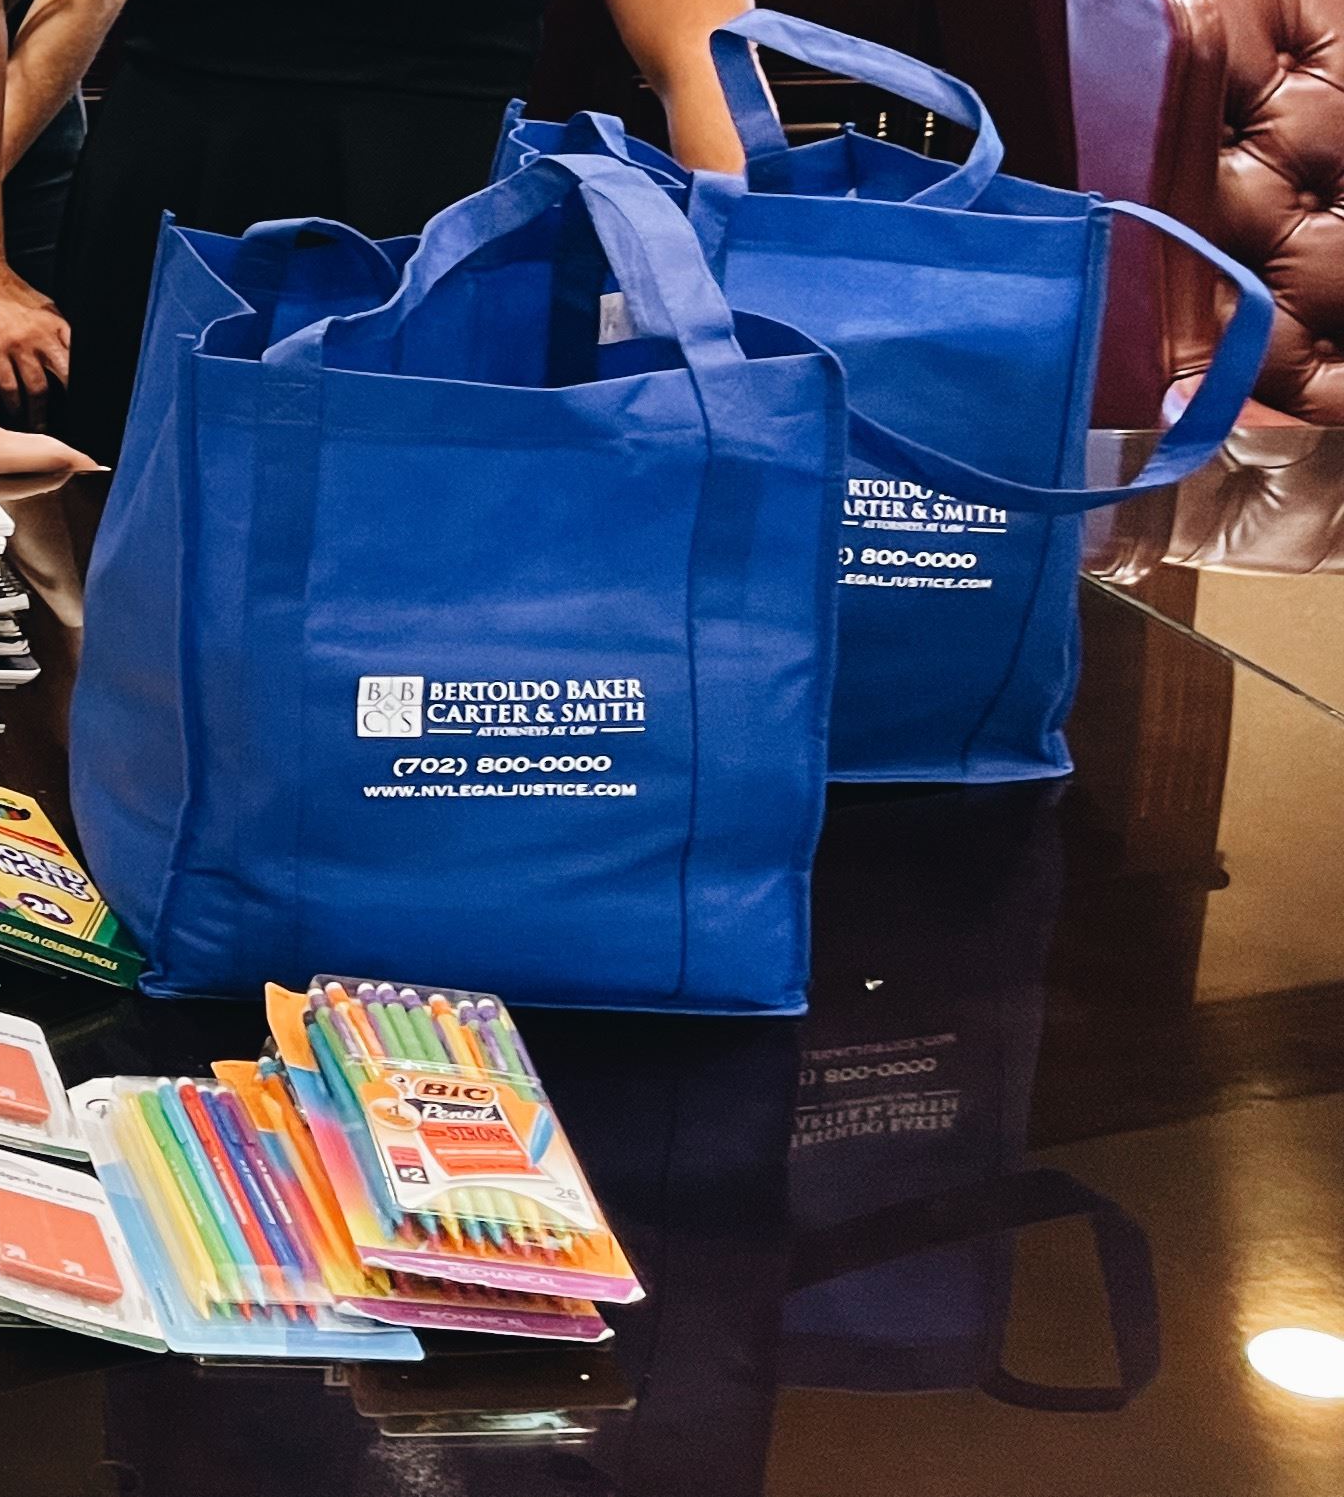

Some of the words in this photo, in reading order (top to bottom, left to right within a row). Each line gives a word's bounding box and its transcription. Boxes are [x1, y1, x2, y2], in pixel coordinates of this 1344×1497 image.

[912, 501, 929, 520] &
[932, 503, 1007, 524] SMITH
[861, 548, 977, 568] 800-0000
[430, 680, 560, 702] BERTOLDO
[565, 679, 645, 699] BAKER
[427, 703, 529, 723] CARTER
[535, 703, 555, 722] &
[560, 702, 645, 722] SMITH
[476, 726, 549, 737] ATTORNEYS
[551, 726, 566, 736] AT
[569, 725, 597, 735] LAW
[392, 757, 468, 776] (702)
[476, 756, 612, 774] 800-0000
[363, 784, 637, 798] WWW.NVLEGALJUSTICE.COM
[20, 896, 71, 923] 24
[41, 937, 82, 958] COLORED
[83, 950, 119, 971] PENCILS
[422, 1083, 488, 1101] BIC
[422, 1104, 496, 1121] Pencil
[447, 1126, 512, 1143] STRONG
[555, 1188, 579, 1200] 26
